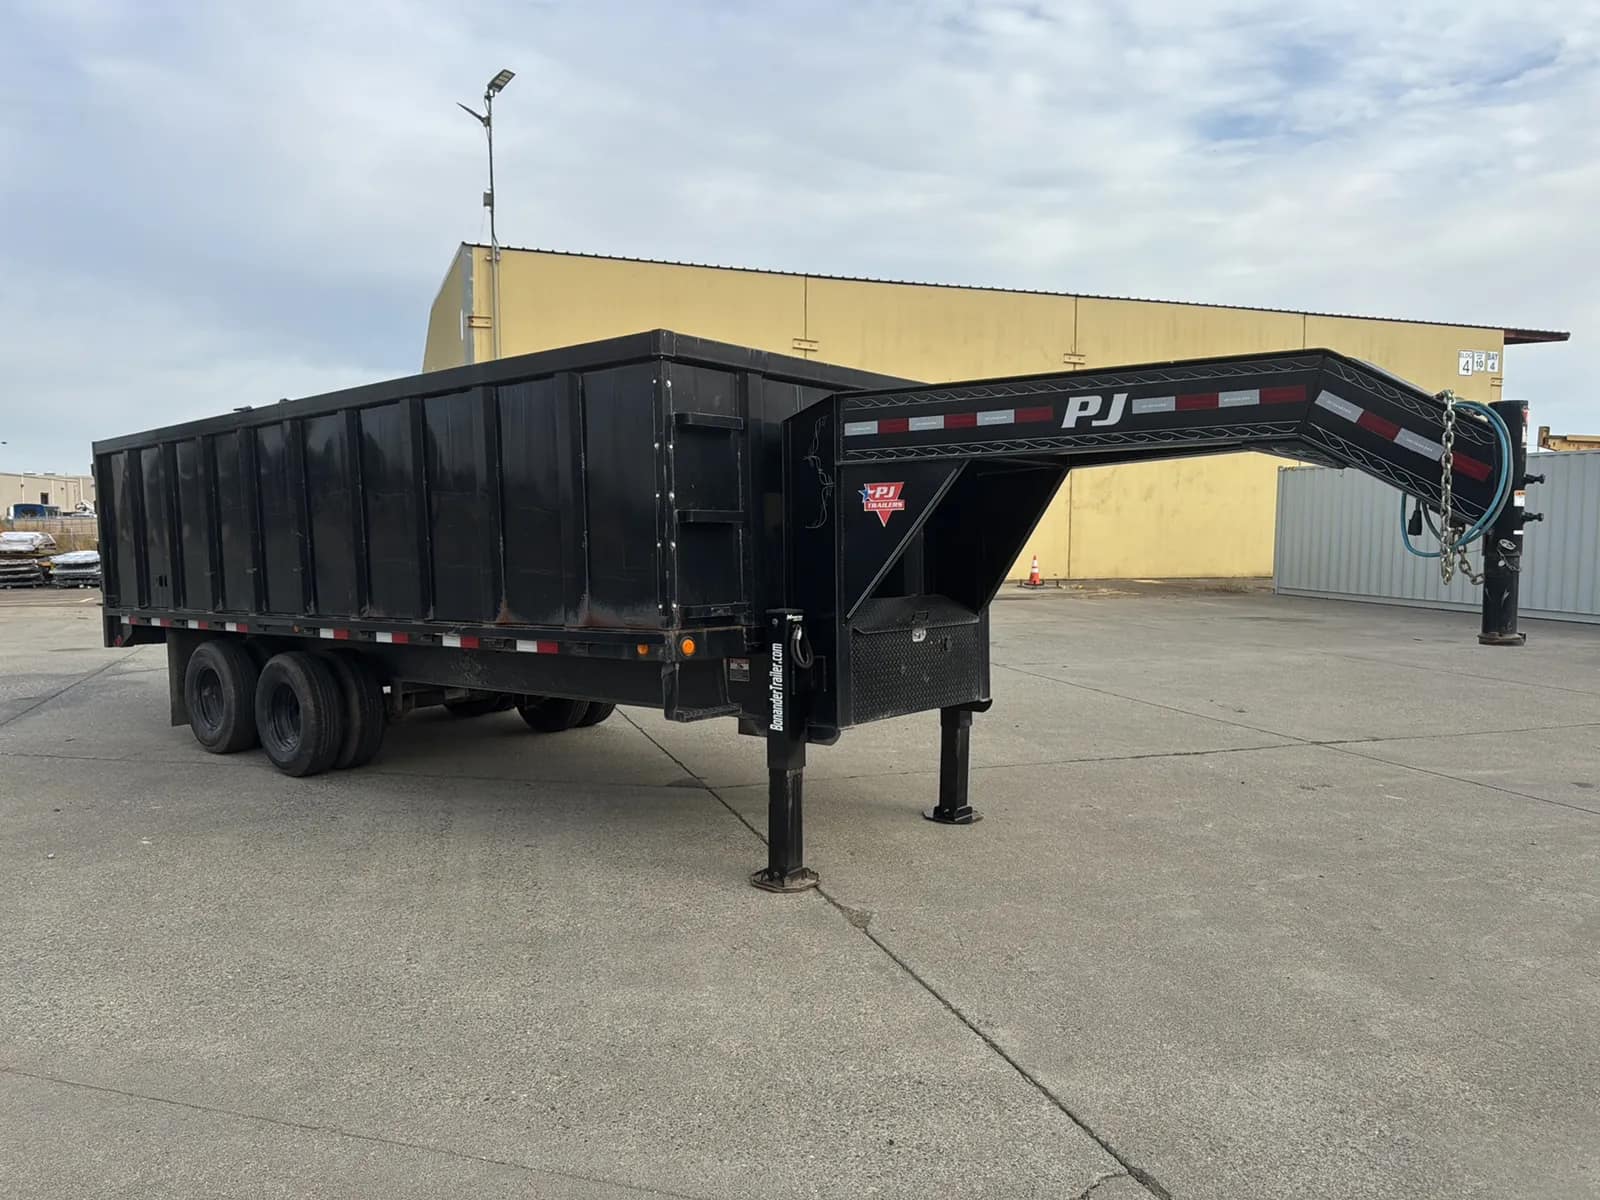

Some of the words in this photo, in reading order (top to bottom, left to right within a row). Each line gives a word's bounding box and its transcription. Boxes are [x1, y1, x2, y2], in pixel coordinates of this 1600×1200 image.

[1463, 360, 1470, 373] 4
[1476, 360, 1484, 368] 10
[1490, 362, 1496, 370] 4
[1061, 393, 1128, 428] PJ
[874, 486, 896, 498] PJ
[769, 642, 783, 732] BonanderTrailer.com
